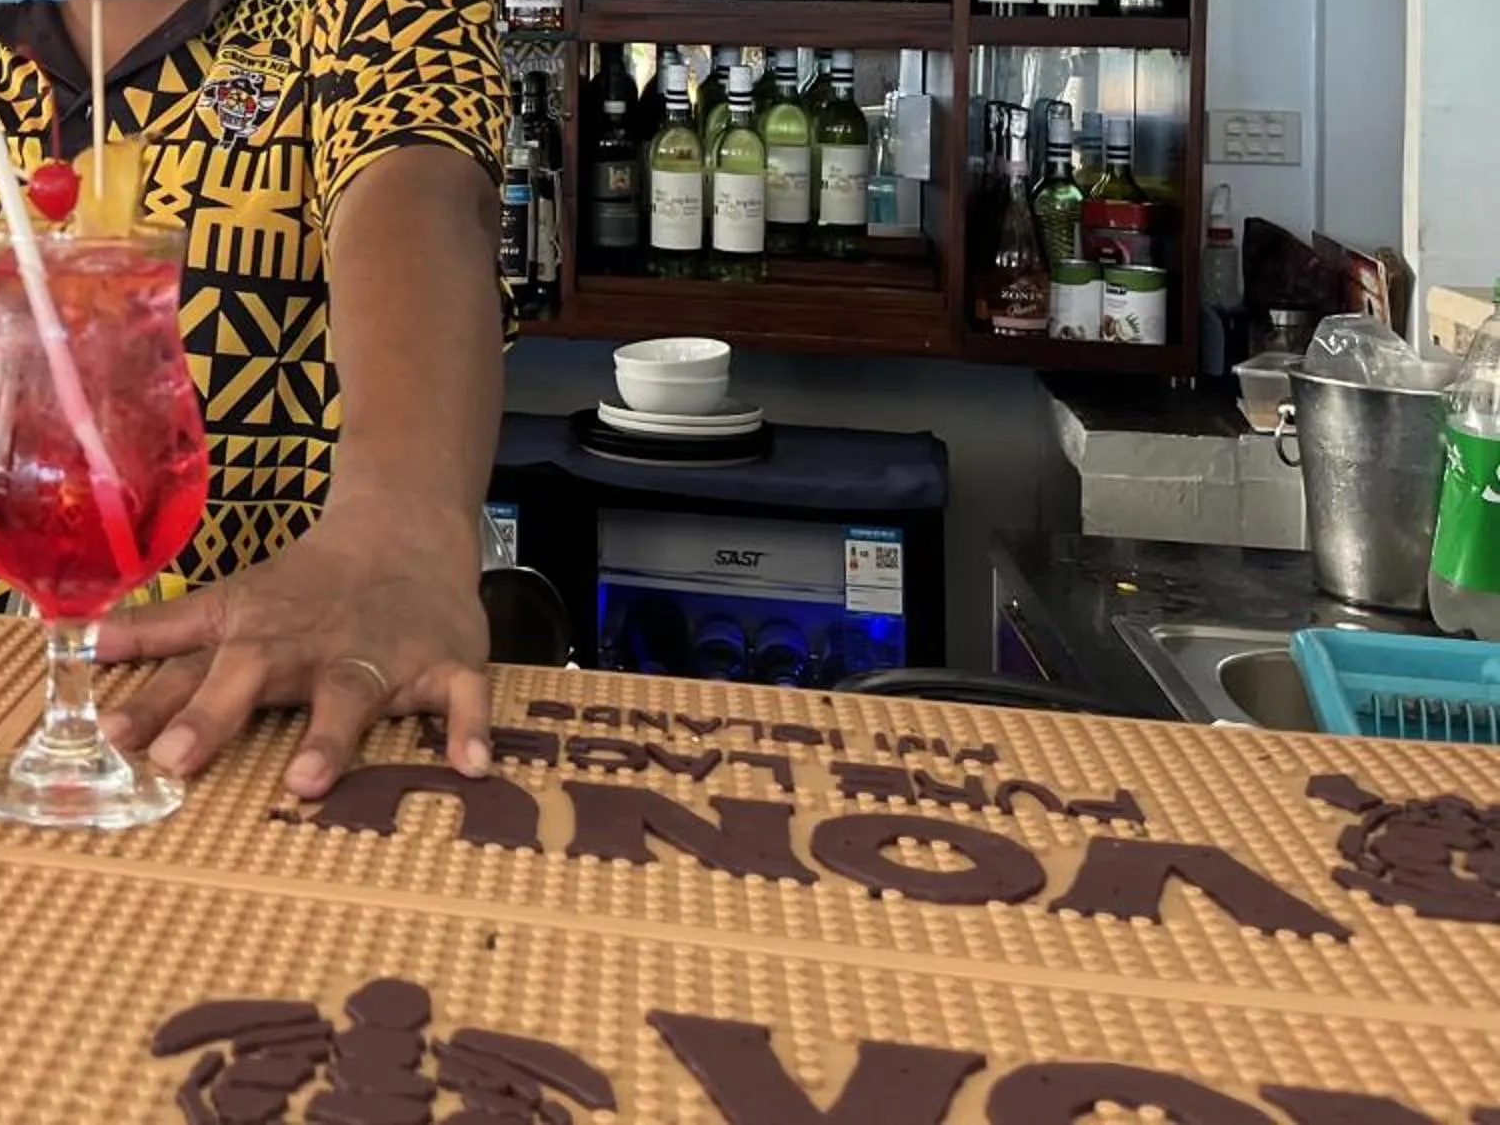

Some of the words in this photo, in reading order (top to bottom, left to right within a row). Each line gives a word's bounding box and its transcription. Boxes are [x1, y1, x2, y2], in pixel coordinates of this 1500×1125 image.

[714, 549, 770, 567] SAST
[829, 761, 1146, 825] PURE
[268, 763, 1355, 944] VONU
